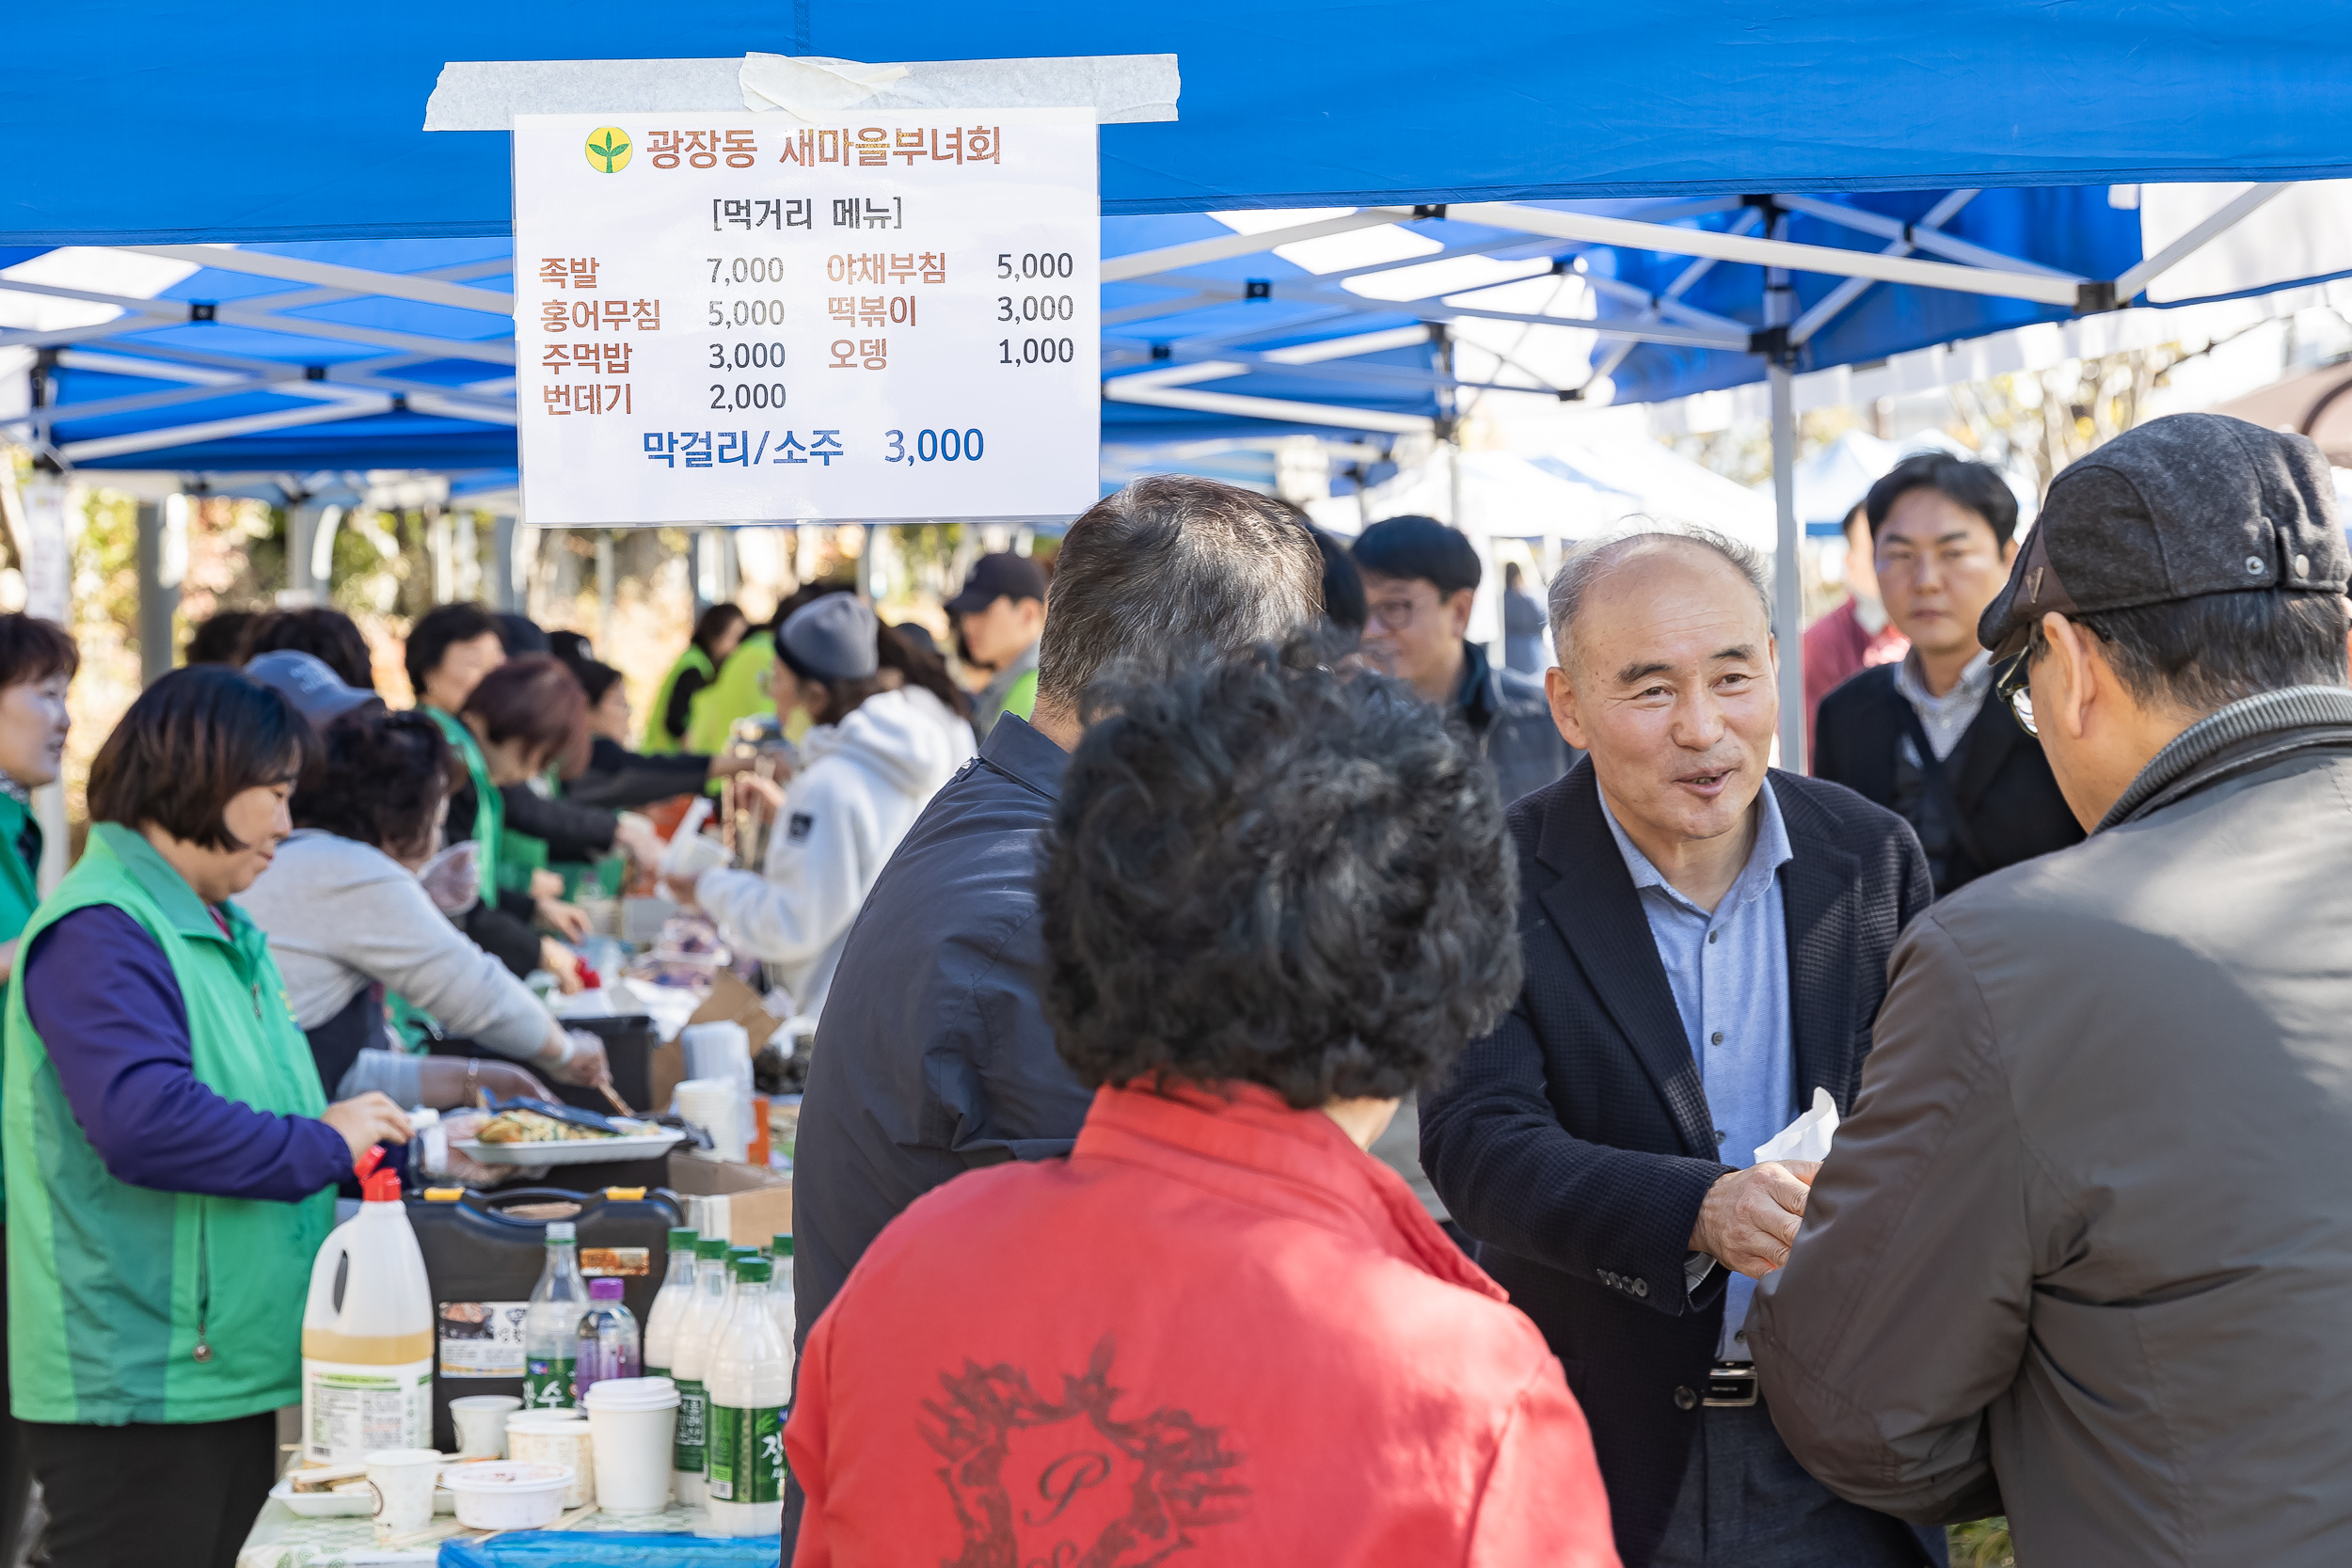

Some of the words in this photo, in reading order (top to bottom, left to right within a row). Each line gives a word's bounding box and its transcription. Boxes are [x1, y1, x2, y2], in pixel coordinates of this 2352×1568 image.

[646, 129, 757, 168] 광장동
[779, 125, 999, 166] 새마을부녀회
[713, 198, 811, 231] [먹거리
[833, 196, 901, 229] 메뉴]
[539, 257, 599, 289] 족발
[707, 257, 783, 284] 7,000
[827, 251, 945, 284] 야채부침
[997, 252, 1073, 280] 5,000
[540, 298, 660, 332] 홍어무침
[708, 299, 784, 328] 5,000
[828, 295, 915, 326] 떡볶이
[997, 294, 1073, 324] 3,000
[542, 342, 632, 374] 주먹밥
[708, 341, 785, 371] 3,000
[828, 338, 886, 370] 오뎅
[999, 337, 1073, 367] 1,000
[543, 383, 630, 415] 번데기
[709, 383, 786, 411] 2,000
[643, 429, 843, 467] 막걸리/소주
[884, 427, 983, 466] 3,000
